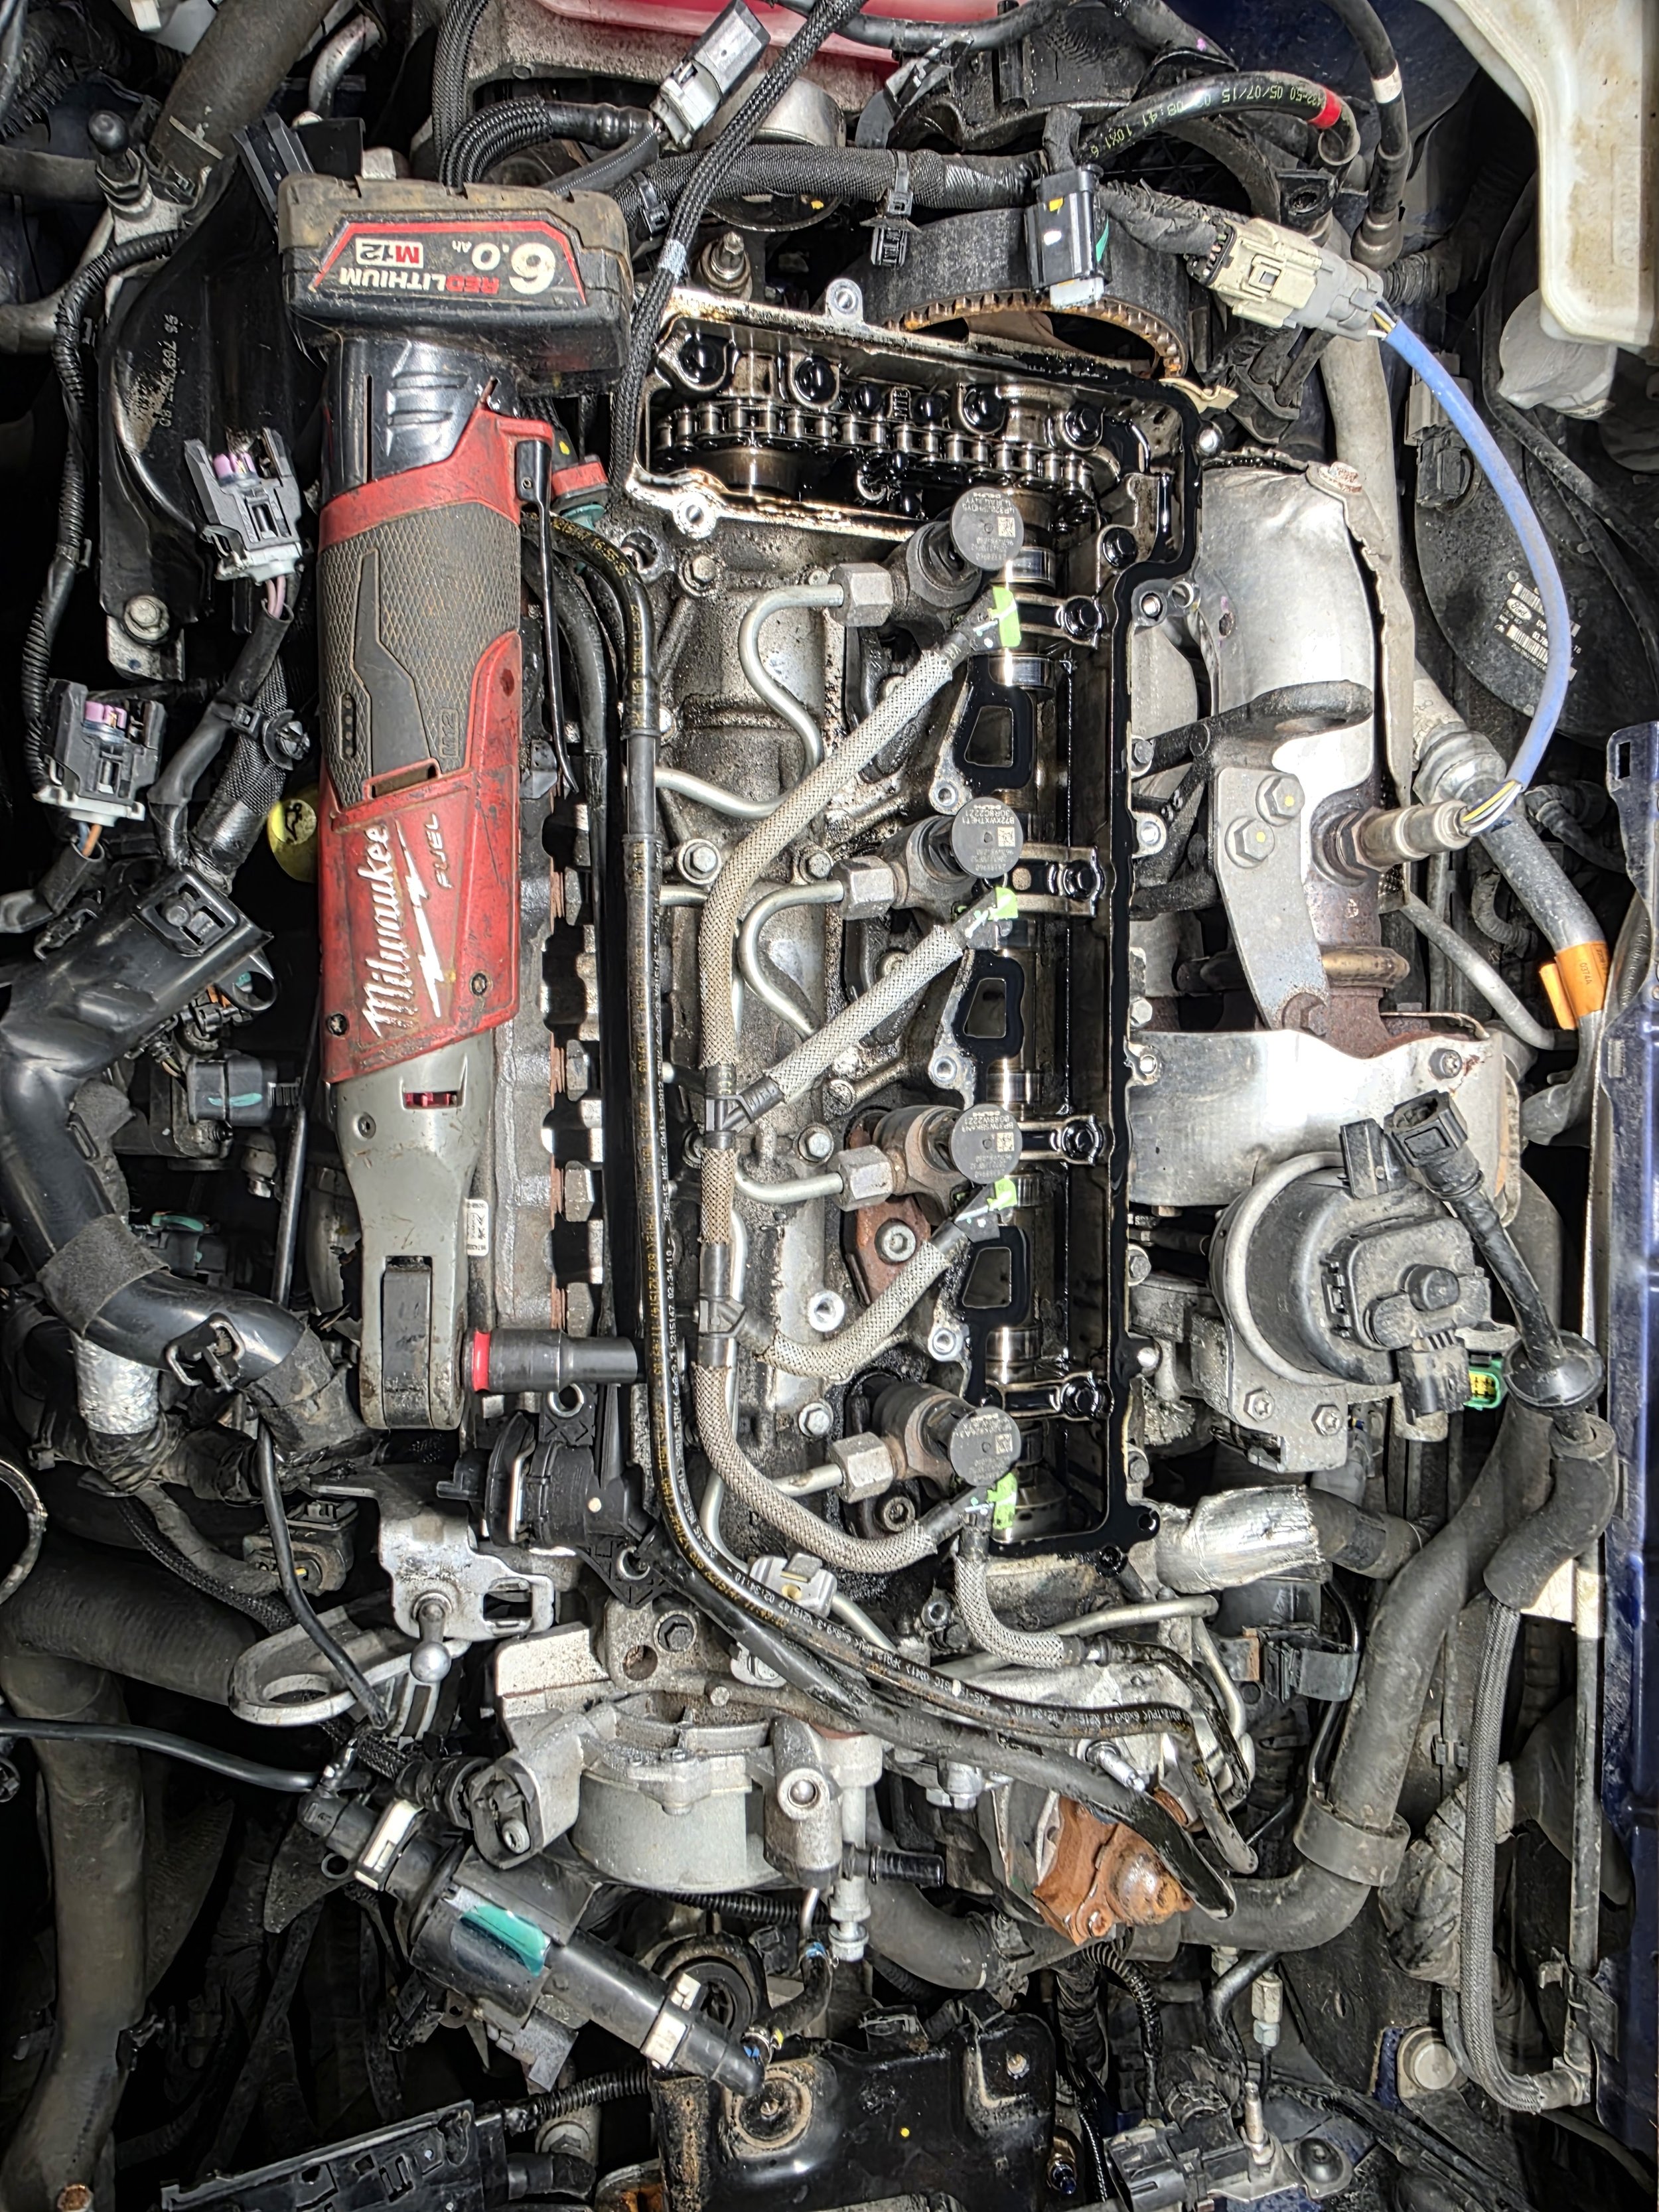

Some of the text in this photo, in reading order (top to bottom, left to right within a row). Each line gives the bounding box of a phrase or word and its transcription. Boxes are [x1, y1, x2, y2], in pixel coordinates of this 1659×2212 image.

[1222, 85, 1283, 104] 05/07/15
[360, 244, 420, 263] M12
[452, 240, 556, 294] 6.0 Ah
[340, 267, 500, 294] REDLITHIUM
[425, 812, 453, 889] FUEL
[358, 823, 418, 1038] Milwaukee
